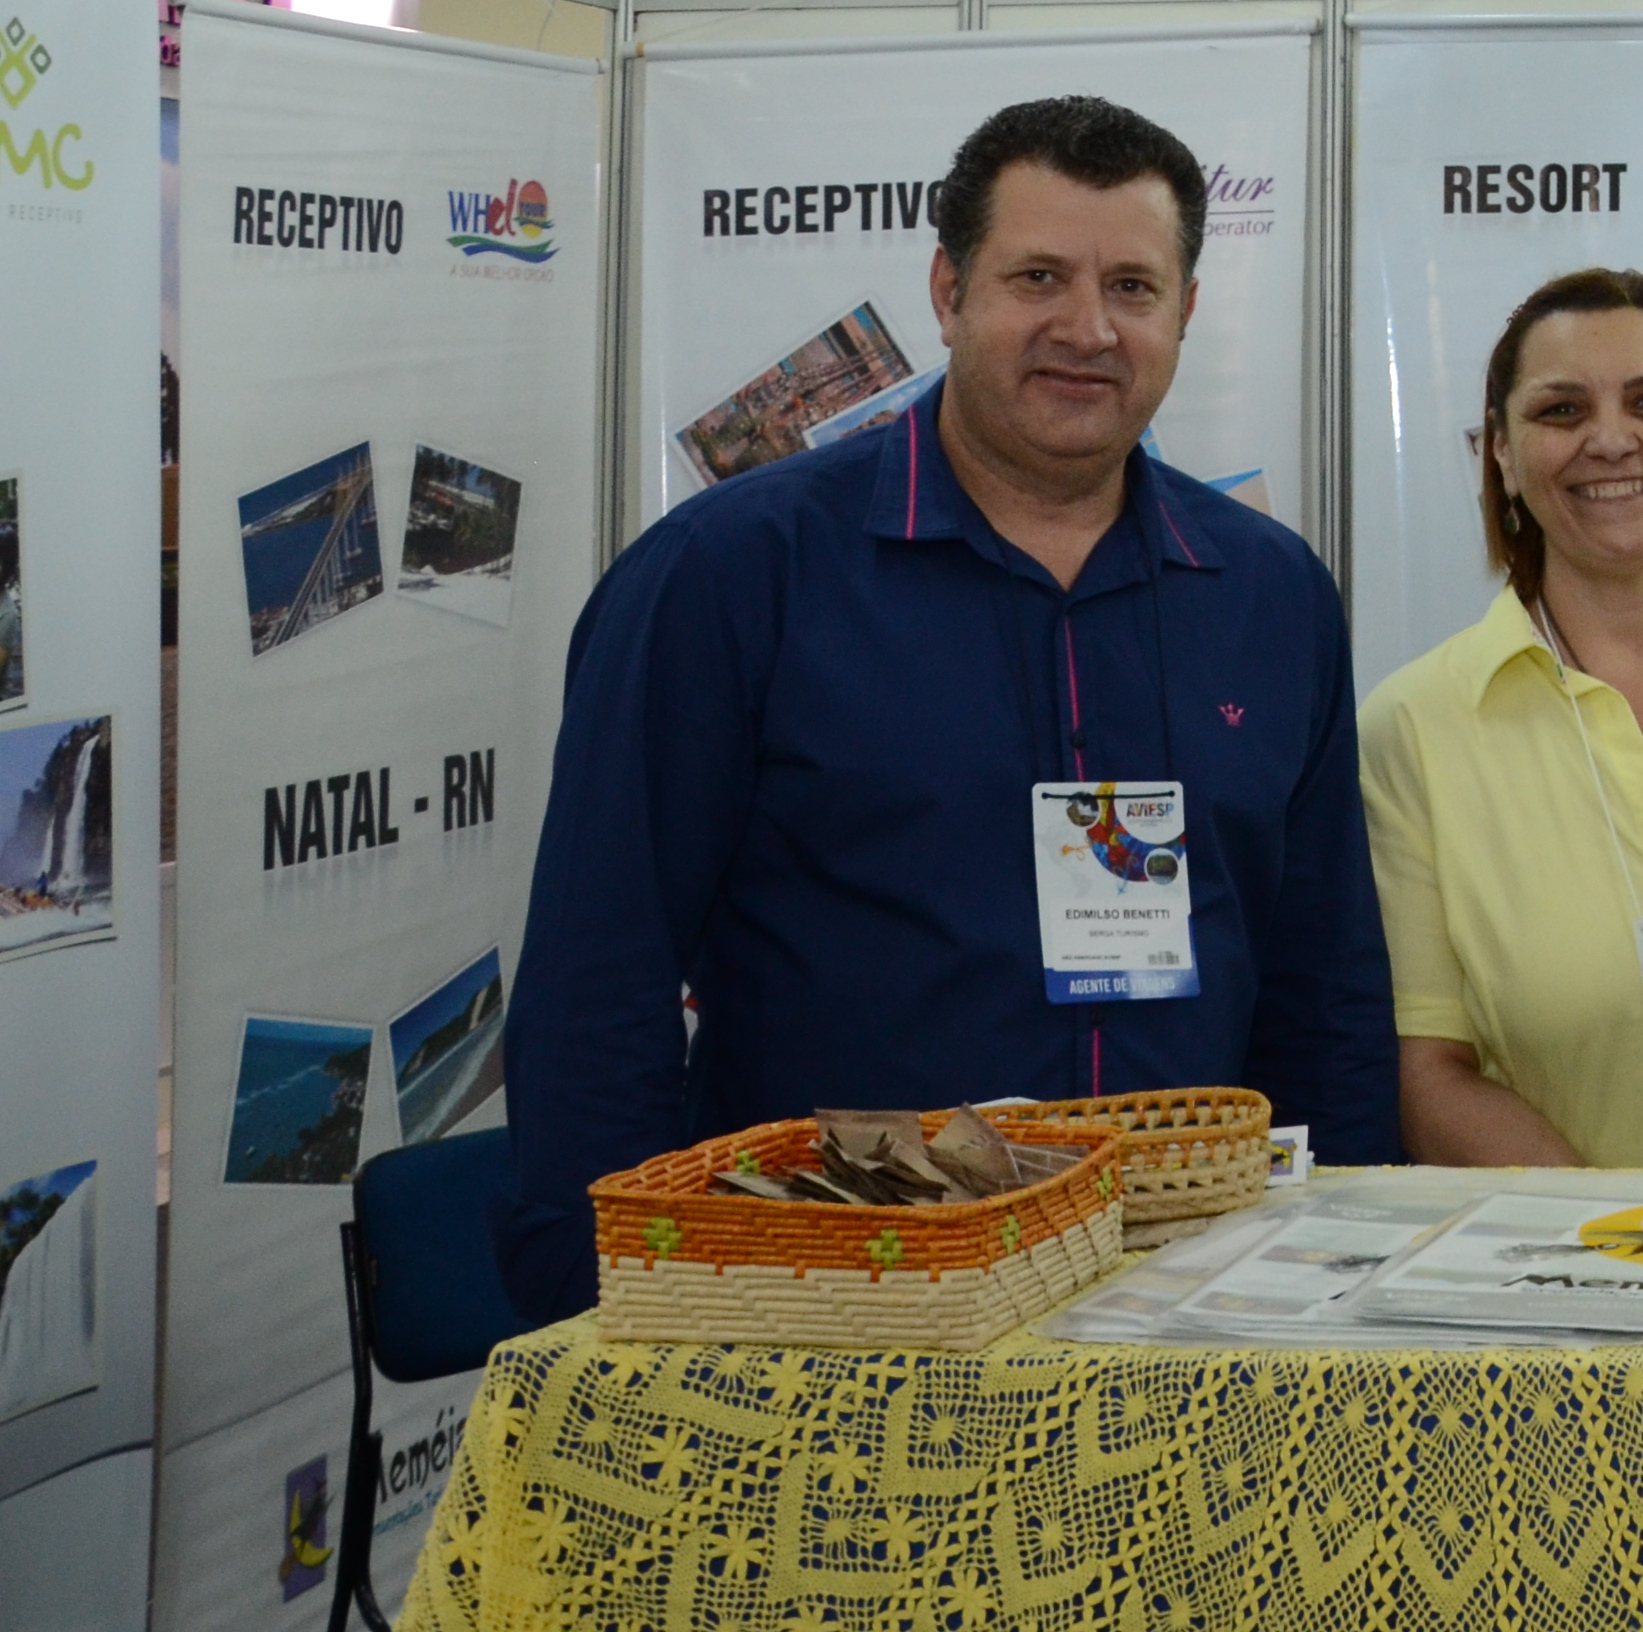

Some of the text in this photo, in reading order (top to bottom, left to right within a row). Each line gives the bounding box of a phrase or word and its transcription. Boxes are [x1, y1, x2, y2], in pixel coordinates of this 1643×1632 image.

[1443, 163, 1628, 215] RESORT
[233, 186, 404, 255] RECEPTIVO
[1202, 221, 1275, 237] perator
[263, 767, 400, 871] NATAL
[443, 748, 496, 831] RN
[1069, 978, 1111, 994] AGENTE
[1113, 977, 1128, 992] DE
